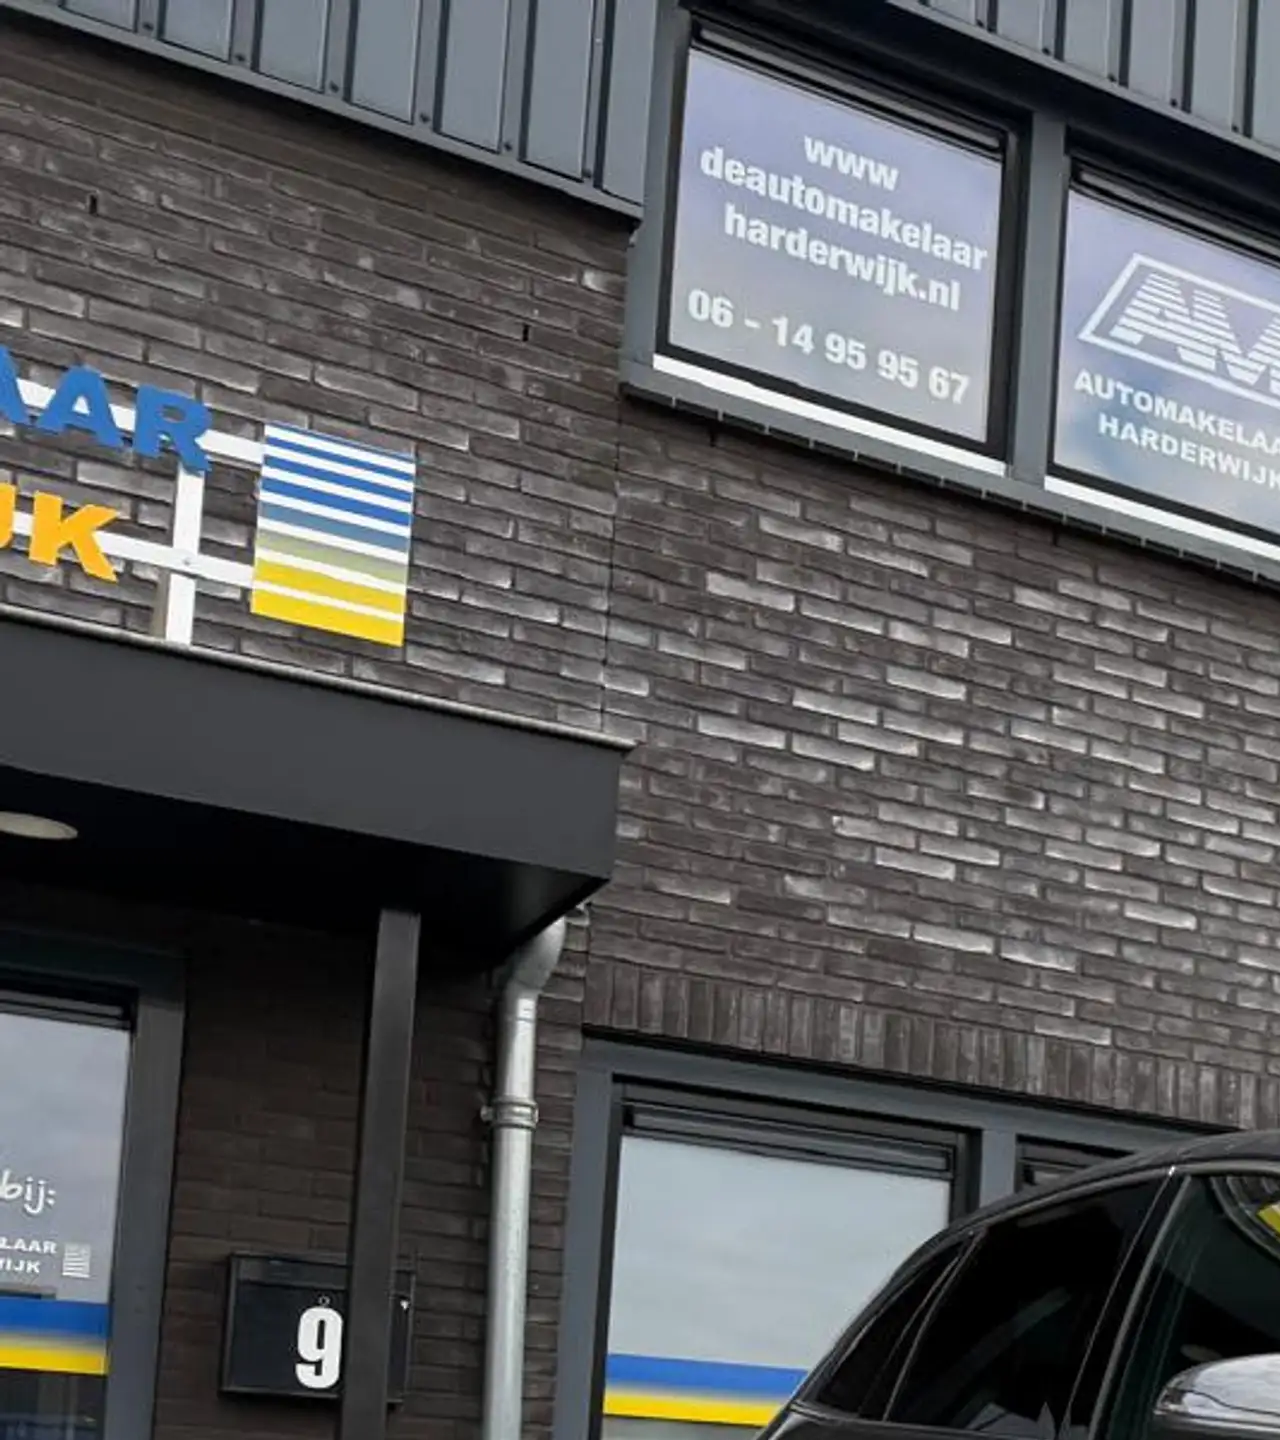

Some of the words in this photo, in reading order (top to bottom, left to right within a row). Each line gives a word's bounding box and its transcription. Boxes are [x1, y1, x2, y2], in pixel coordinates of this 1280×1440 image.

[700, 146, 988, 270] deautomakelaar
[803, 135, 899, 191] www
[724, 202, 961, 311] harderwijk.nl
[687, 288, 734, 329] 06
[772, 315, 815, 355] 14
[824, 332, 867, 371] 95
[877, 349, 920, 389] 95
[928, 366, 970, 404] 67
[295, 1306, 344, 1389] 9
